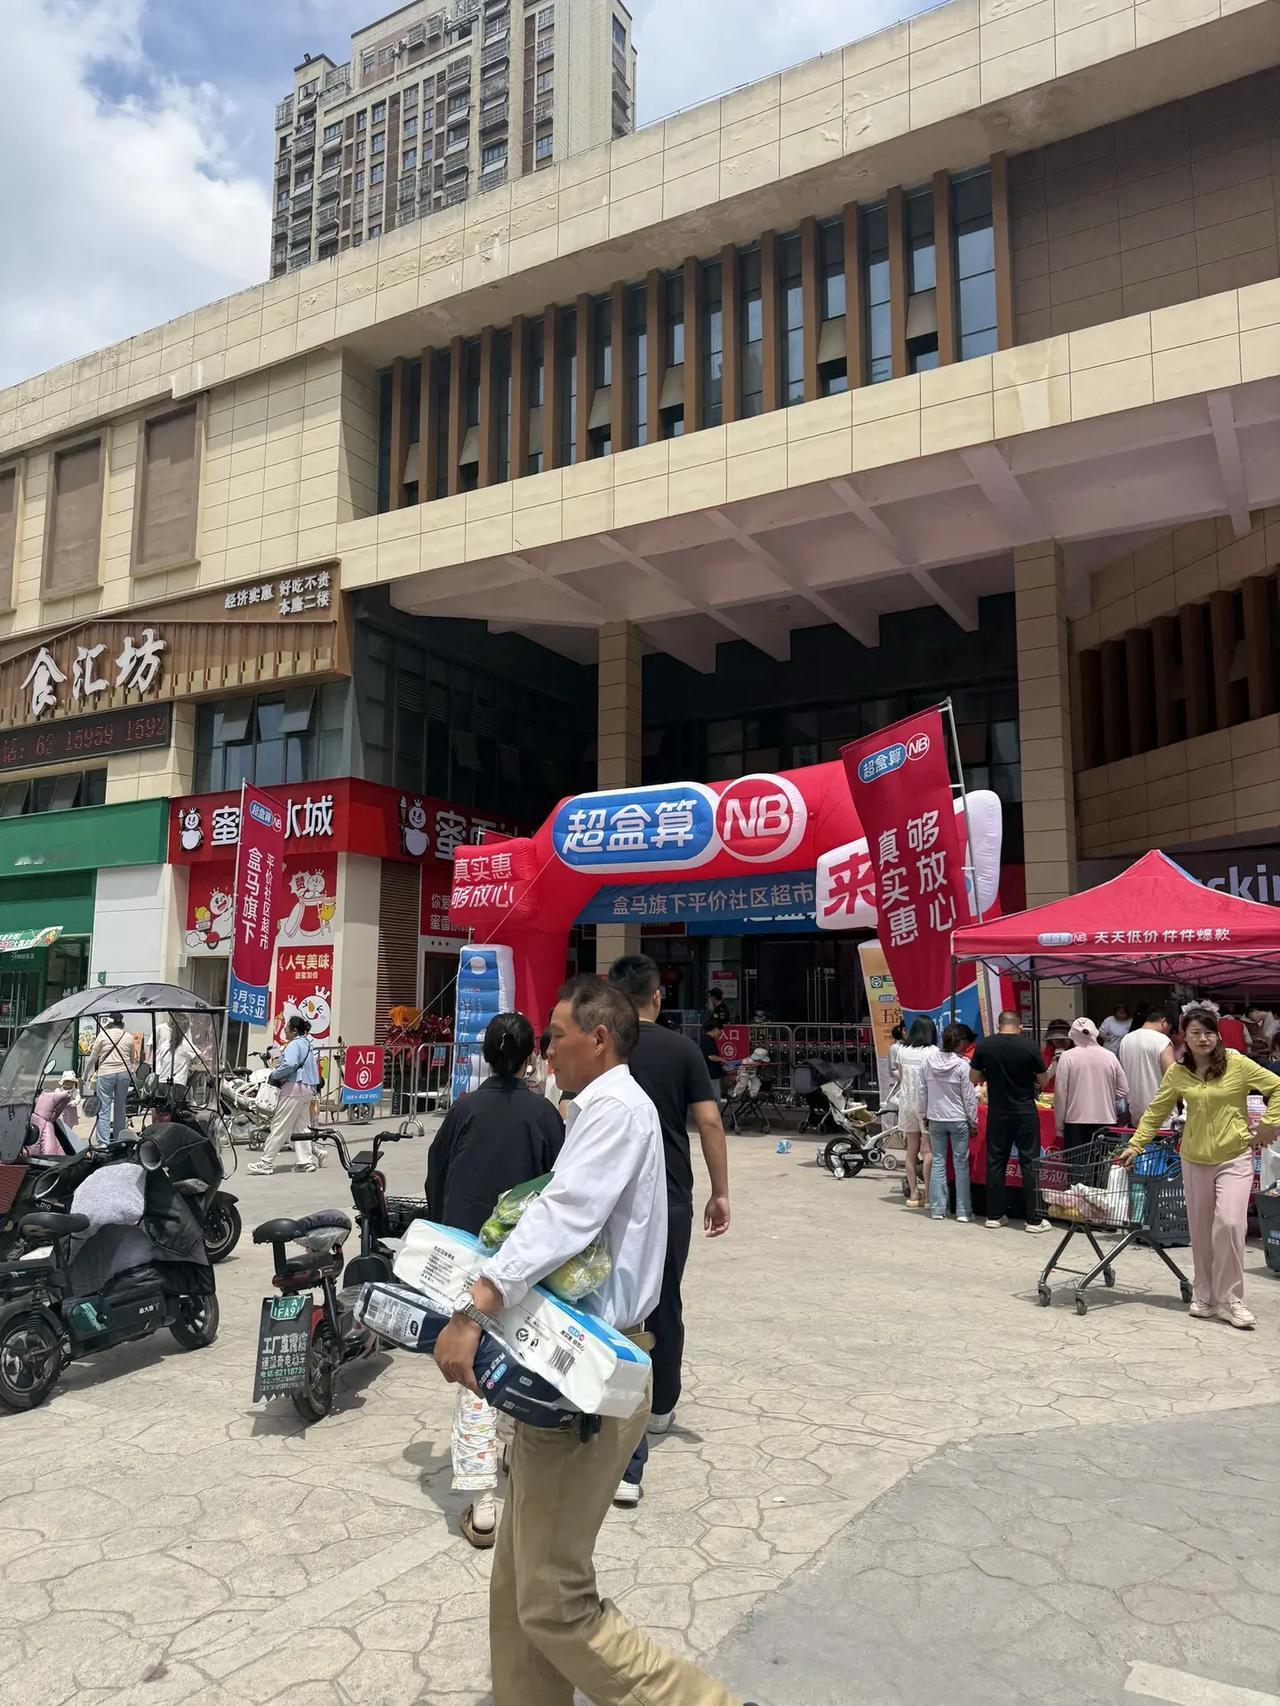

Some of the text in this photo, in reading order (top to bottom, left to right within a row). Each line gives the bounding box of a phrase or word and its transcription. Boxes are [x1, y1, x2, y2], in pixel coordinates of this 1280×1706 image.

[224, 571, 330, 609] 经济实惠 好吃不贵
[20, 629, 167, 716] 食汇坊
[863, 737, 929, 779] 超盒算 NB
[252, 804, 273, 823] 超盒算
[562, 793, 791, 855] 超盒算 NB
[453, 853, 513, 884] 真实惠
[824, 853, 877, 916] 来
[906, 809, 957, 932] 够放心
[241, 847, 263, 944] 盒马旗下
[260, 853, 275, 950] 平价社区超市
[451, 882, 514, 909] 够放心
[612, 882, 815, 916] 盒马旗下平价社区超市
[878, 827, 919, 948] 真实惠
[1095, 930, 1159, 945] 天天低价
[1162, 928, 1231, 943] 件件爆款
[285, 954, 330, 971] 人气美味
[719, 1030, 739, 1041] 入口
[356, 1051, 376, 1065] 入口
[262, 1332, 309, 1355] 工厂直营店
